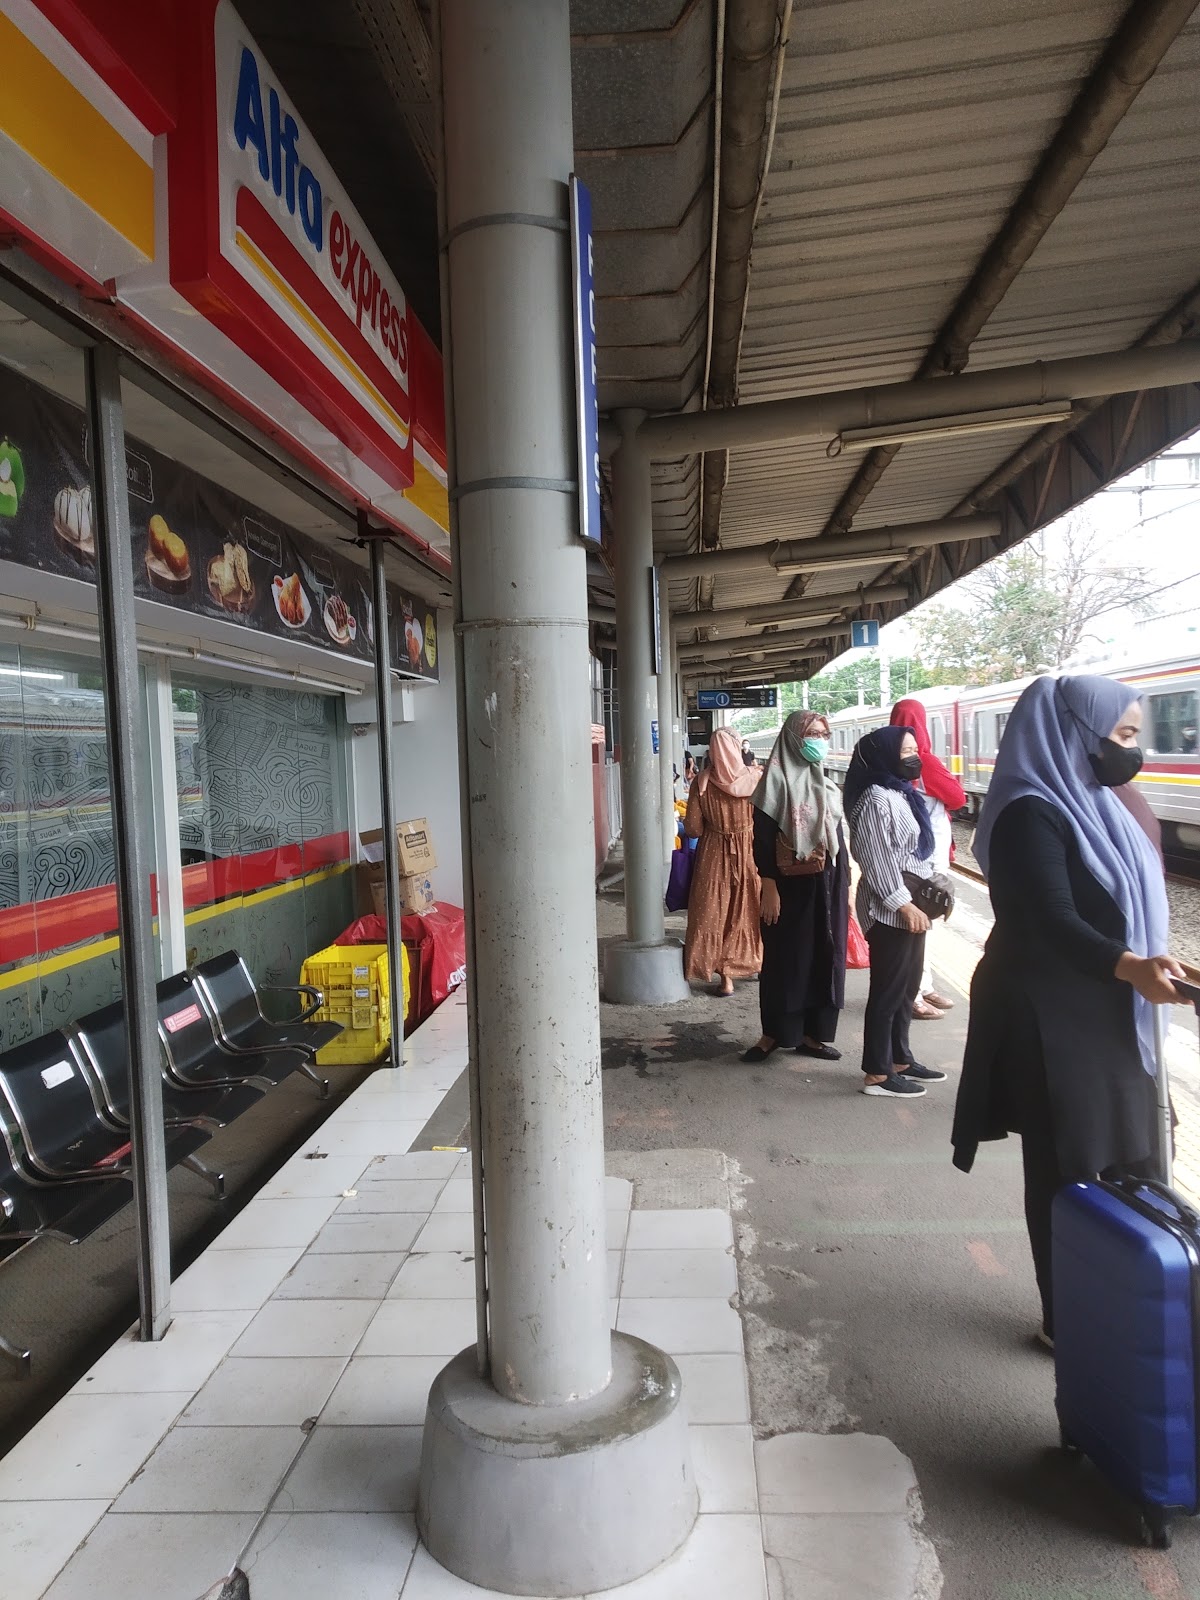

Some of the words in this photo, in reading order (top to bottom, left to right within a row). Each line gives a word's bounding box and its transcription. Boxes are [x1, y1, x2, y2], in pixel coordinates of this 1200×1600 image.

[234, 47, 323, 253] Alfa
[330, 210, 408, 374] express
[860, 624, 869, 644] 1
[39, 828, 62, 840] SUGAR
